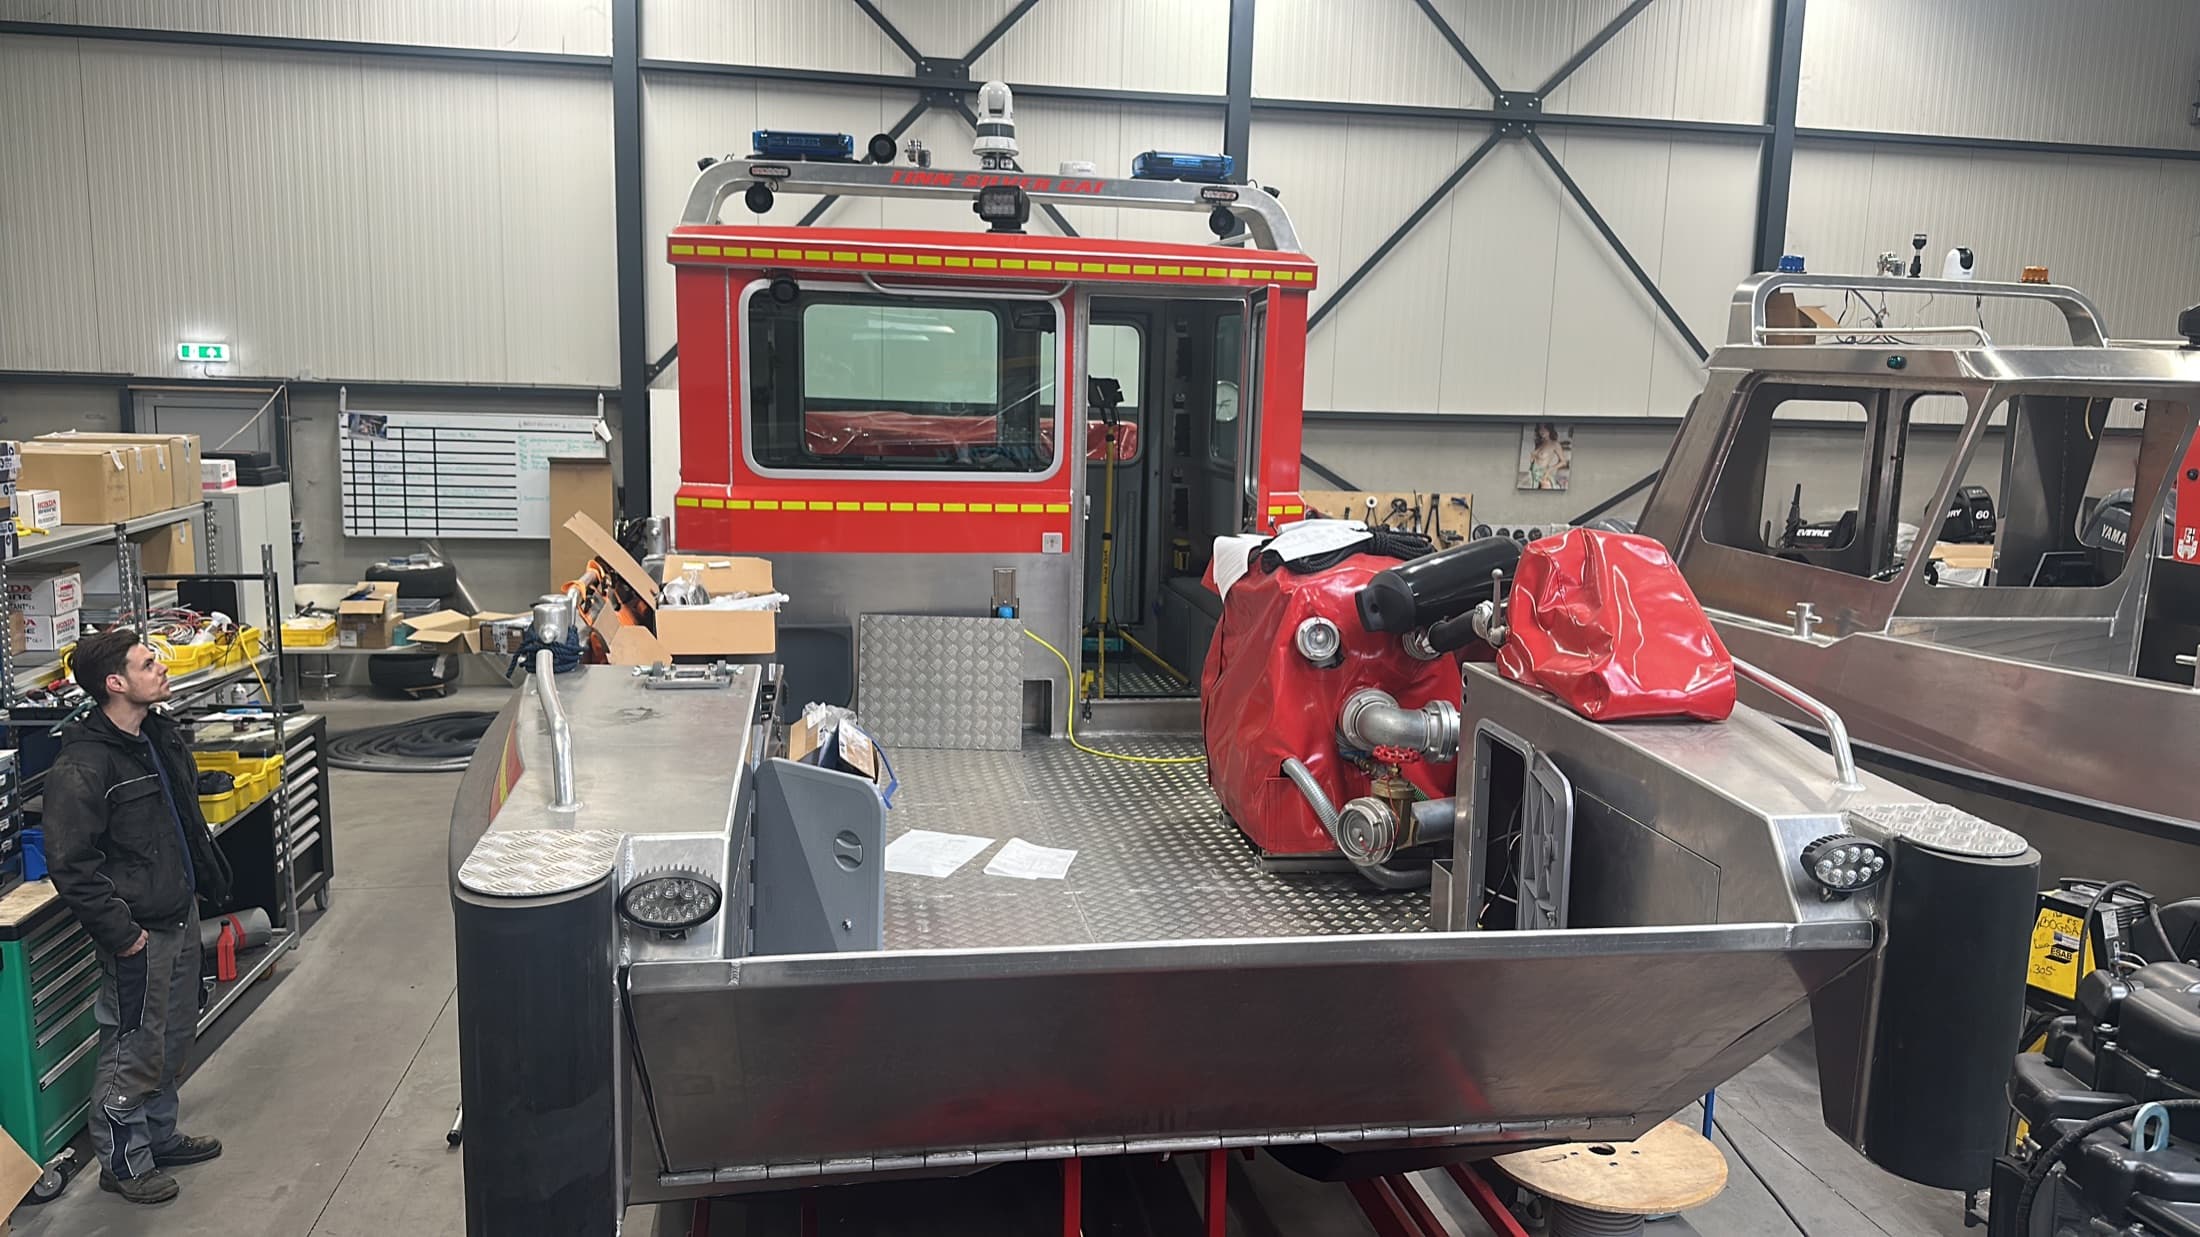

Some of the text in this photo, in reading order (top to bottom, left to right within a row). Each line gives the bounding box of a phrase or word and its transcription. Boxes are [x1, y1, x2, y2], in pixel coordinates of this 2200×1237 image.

[1975, 510, 1990, 519] 60
[2101, 524, 2127, 546] YAMA
[2050, 947, 2073, 960] ESAB
